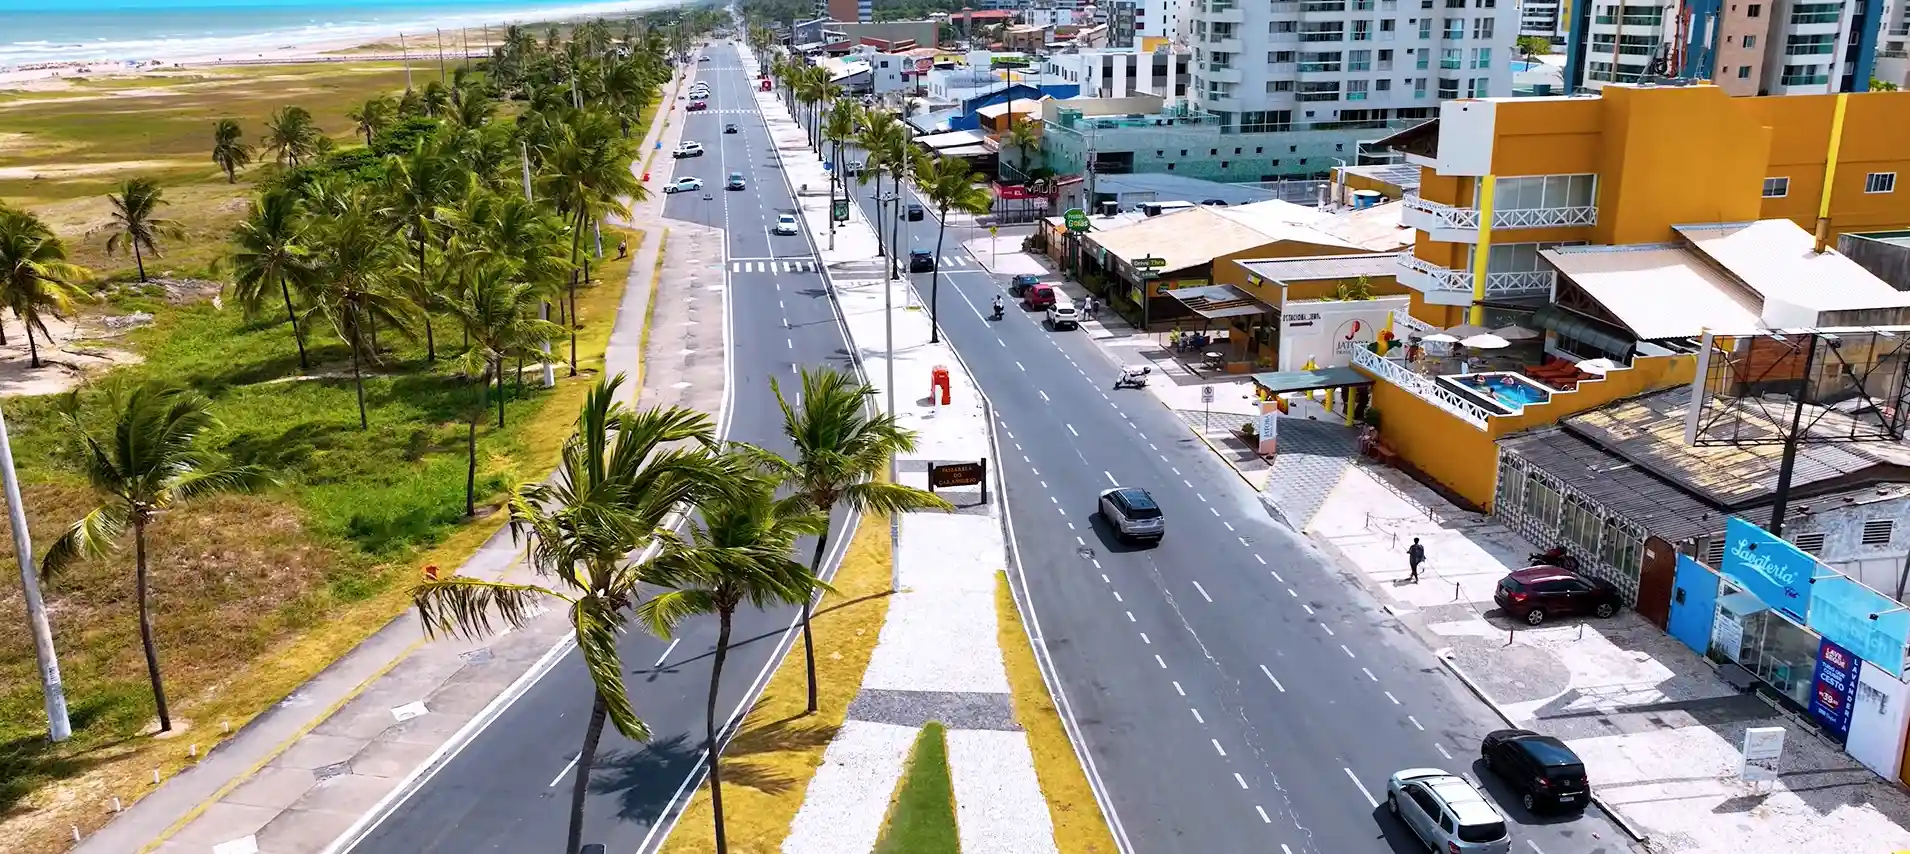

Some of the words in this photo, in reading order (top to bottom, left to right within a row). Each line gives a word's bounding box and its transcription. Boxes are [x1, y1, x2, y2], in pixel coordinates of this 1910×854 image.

[1731, 538, 1794, 585] Lavateria
[1820, 673, 1845, 691] CESTO
[1841, 658, 1859, 732] LAVANDERIA
